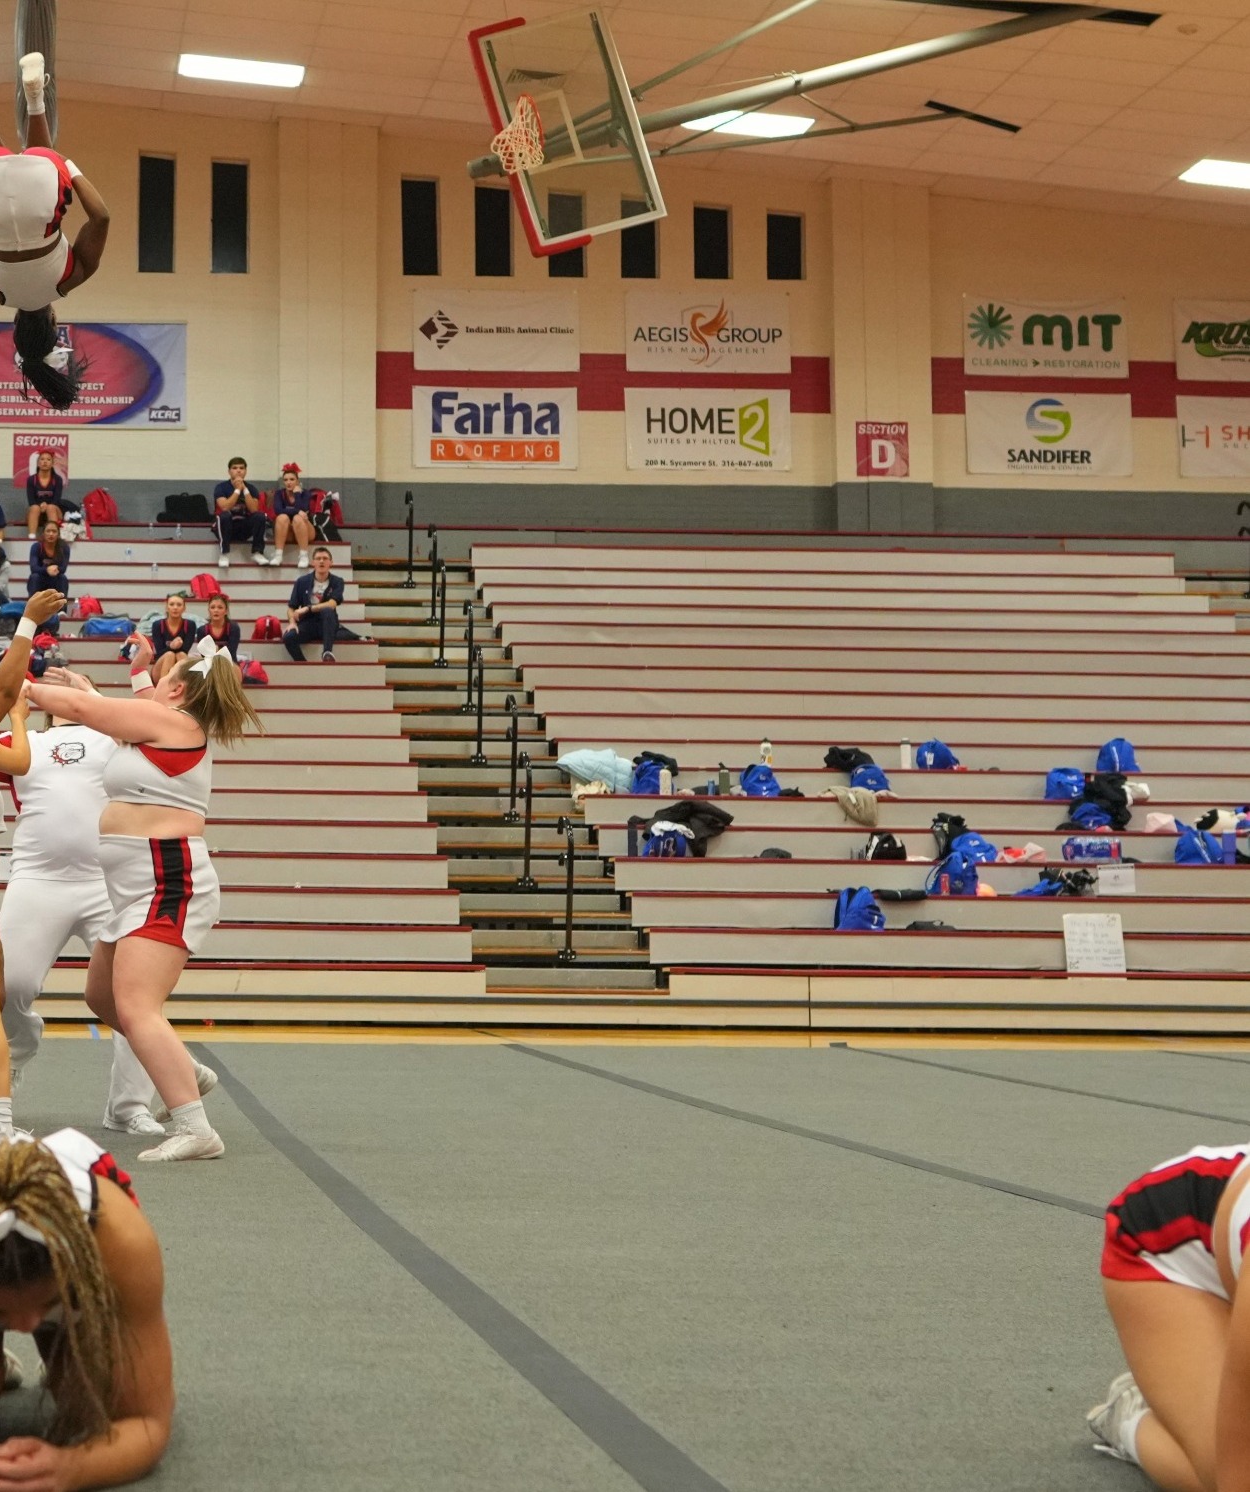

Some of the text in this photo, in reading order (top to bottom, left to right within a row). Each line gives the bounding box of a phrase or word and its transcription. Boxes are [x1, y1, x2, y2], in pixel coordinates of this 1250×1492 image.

[465, 325, 574, 335] Indian Hills Animal Clinic
[634, 326, 783, 344] AEGIS GROUP
[647, 345, 766, 355] RISK MANAGEMENT
[971, 357, 1121, 369] CLEANING RESTORATION
[42, 408, 102, 417] LEADERSHIP
[150, 410, 180, 419] KCAC
[431, 391, 560, 436] Farha
[646, 401, 767, 451] HOME 2
[858, 423, 907, 435] SECTION
[15, 436, 67, 447] SECTION
[436, 443, 554, 459] ROOFING
[871, 439, 895, 469] D
[1007, 449, 1092, 464] SANDIFER
[670, 459, 706, 468] Sycamore
[708, 459, 718, 467] St.
